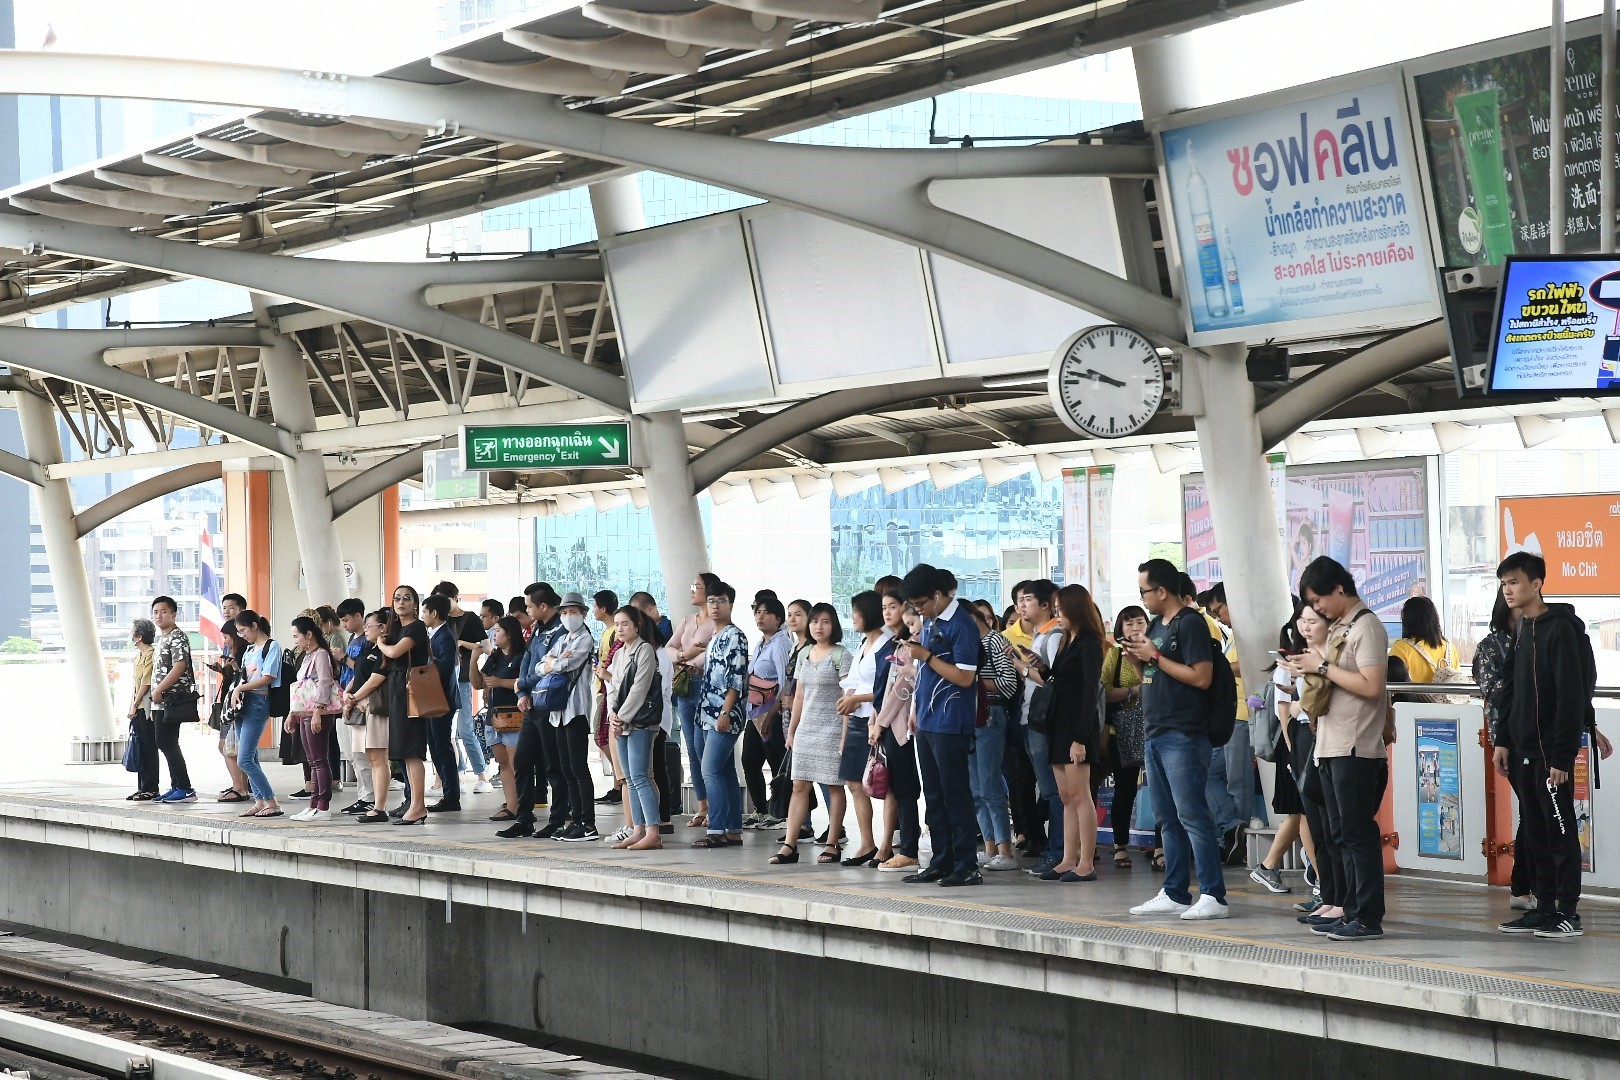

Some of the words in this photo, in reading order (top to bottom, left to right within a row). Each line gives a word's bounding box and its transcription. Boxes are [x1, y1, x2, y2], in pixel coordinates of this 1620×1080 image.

[1577, 89, 1599, 99] NOBU
[1227, 97, 1398, 196] ซอฟคลีน
[1570, 180, 1602, 209] 洗面
[1264, 193, 1407, 237] น้ำเกลือทำความสะอาด
[1274, 252, 1326, 281] สะอาดใส
[1327, 243, 1415, 277] ไม่ระคายเคือง
[1528, 282, 1584, 301] รถไฟฟ้า
[1521, 299, 1586, 317] ขบวนไหน
[502, 431, 592, 453] ทางออกฉุกเฉิน
[503, 452, 556, 463] Emergency
[561, 451, 579, 460] Exit
[1557, 522, 1603, 548] หมอชิต
[1562, 562, 1576, 577] Mo
[1578, 561, 1598, 577] Chit
